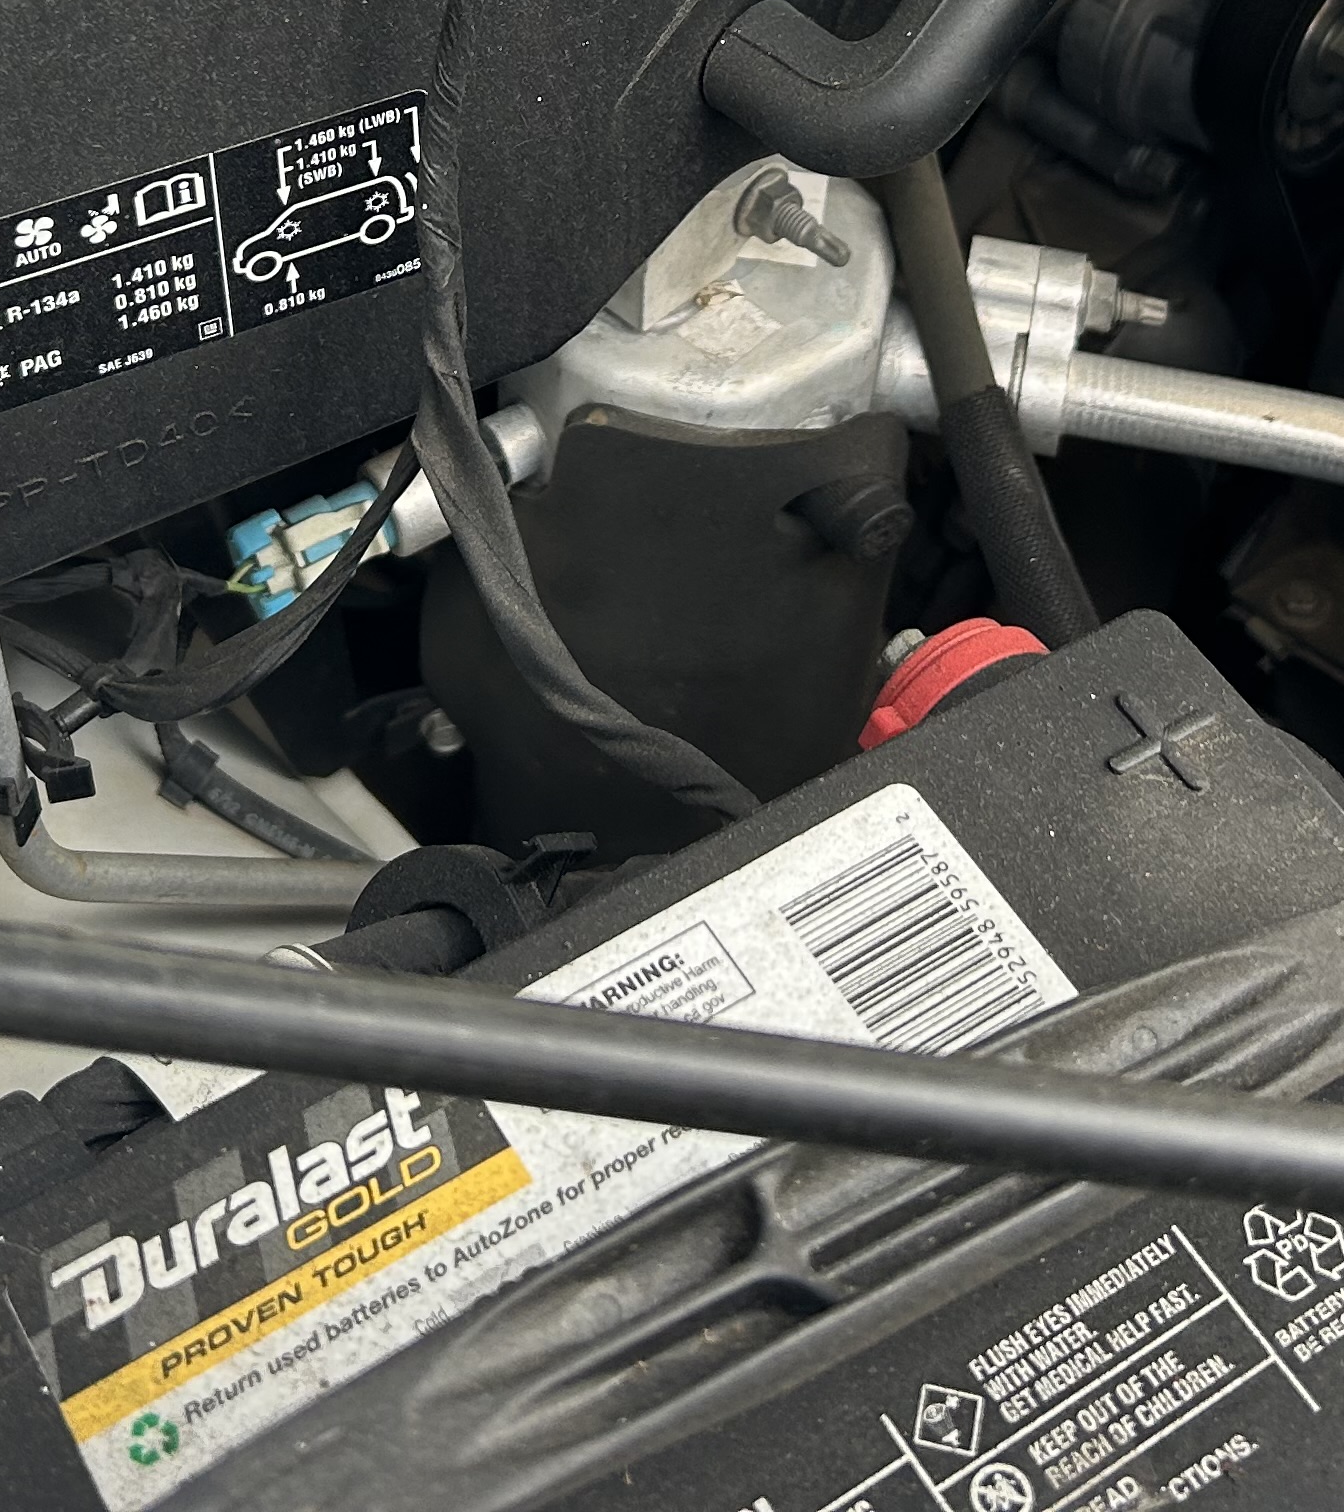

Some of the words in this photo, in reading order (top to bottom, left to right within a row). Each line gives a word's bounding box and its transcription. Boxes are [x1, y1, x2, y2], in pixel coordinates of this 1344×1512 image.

[294, 129, 335, 152] 1.460
[338, 124, 355, 139] kg
[358, 108, 401, 134] (LWB)
[296, 147, 337, 171] 1.410
[339, 143, 357, 157] kg
[298, 162, 343, 189] (SWB)
[15, 242, 62, 268] AUTO
[111, 259, 167, 289] 1.410
[171, 252, 195, 272] kg
[7, 290, 81, 323] R-134a
[114, 280, 170, 310] 0.810
[174, 273, 198, 292] kg
[117, 300, 173, 330] 1.460
[177, 293, 200, 313] kg
[264, 292, 305, 316] 0.810
[309, 287, 326, 302] kg
[20, 349, 63, 377] PAG
[98, 358, 122, 374] SAE
[124, 348, 154, 366] J639
[920, 852, 979, 912] 59587
[978, 919, 1036, 985] 52948
[51, 1088, 432, 1331] Duralast
[286, 1145, 442, 1250] GOLD
[161, 1282, 303, 1379] PROVEN
[312, 1212, 428, 1288] TOUGH
[184, 1368, 262, 1423] Return
[267, 1330, 321, 1375] used
[325, 1277, 422, 1343] batteries
[424, 1262, 448, 1283] to
[454, 1199, 554, 1269] AutoZone
[556, 1177, 586, 1206] for
[589, 1136, 657, 1190] proper
[968, 1330, 1032, 1382] FLUSH
[1022, 1303, 1073, 1346] EYES
[1065, 1234, 1177, 1317] IMMEDIATELY
[983, 1358, 1036, 1402] WITH
[1028, 1321, 1099, 1372] WATER.
[999, 1388, 1039, 1424] GET
[1034, 1341, 1114, 1402] MEDICAL
[1105, 1311, 1152, 1353] HELP
[1148, 1283, 1202, 1325] FAST.
[1293, 1335, 1324, 1363] BE
[1027, 1419, 1078, 1466] KEEP
[1076, 1392, 1120, 1433] OUT
[1115, 1374, 1146, 1406] OF
[1140, 1350, 1186, 1388] THE
[1044, 1433, 1115, 1489] REACH
[1108, 1414, 1138, 1445] OF
[1134, 1354, 1237, 1428] CHILDREN.
